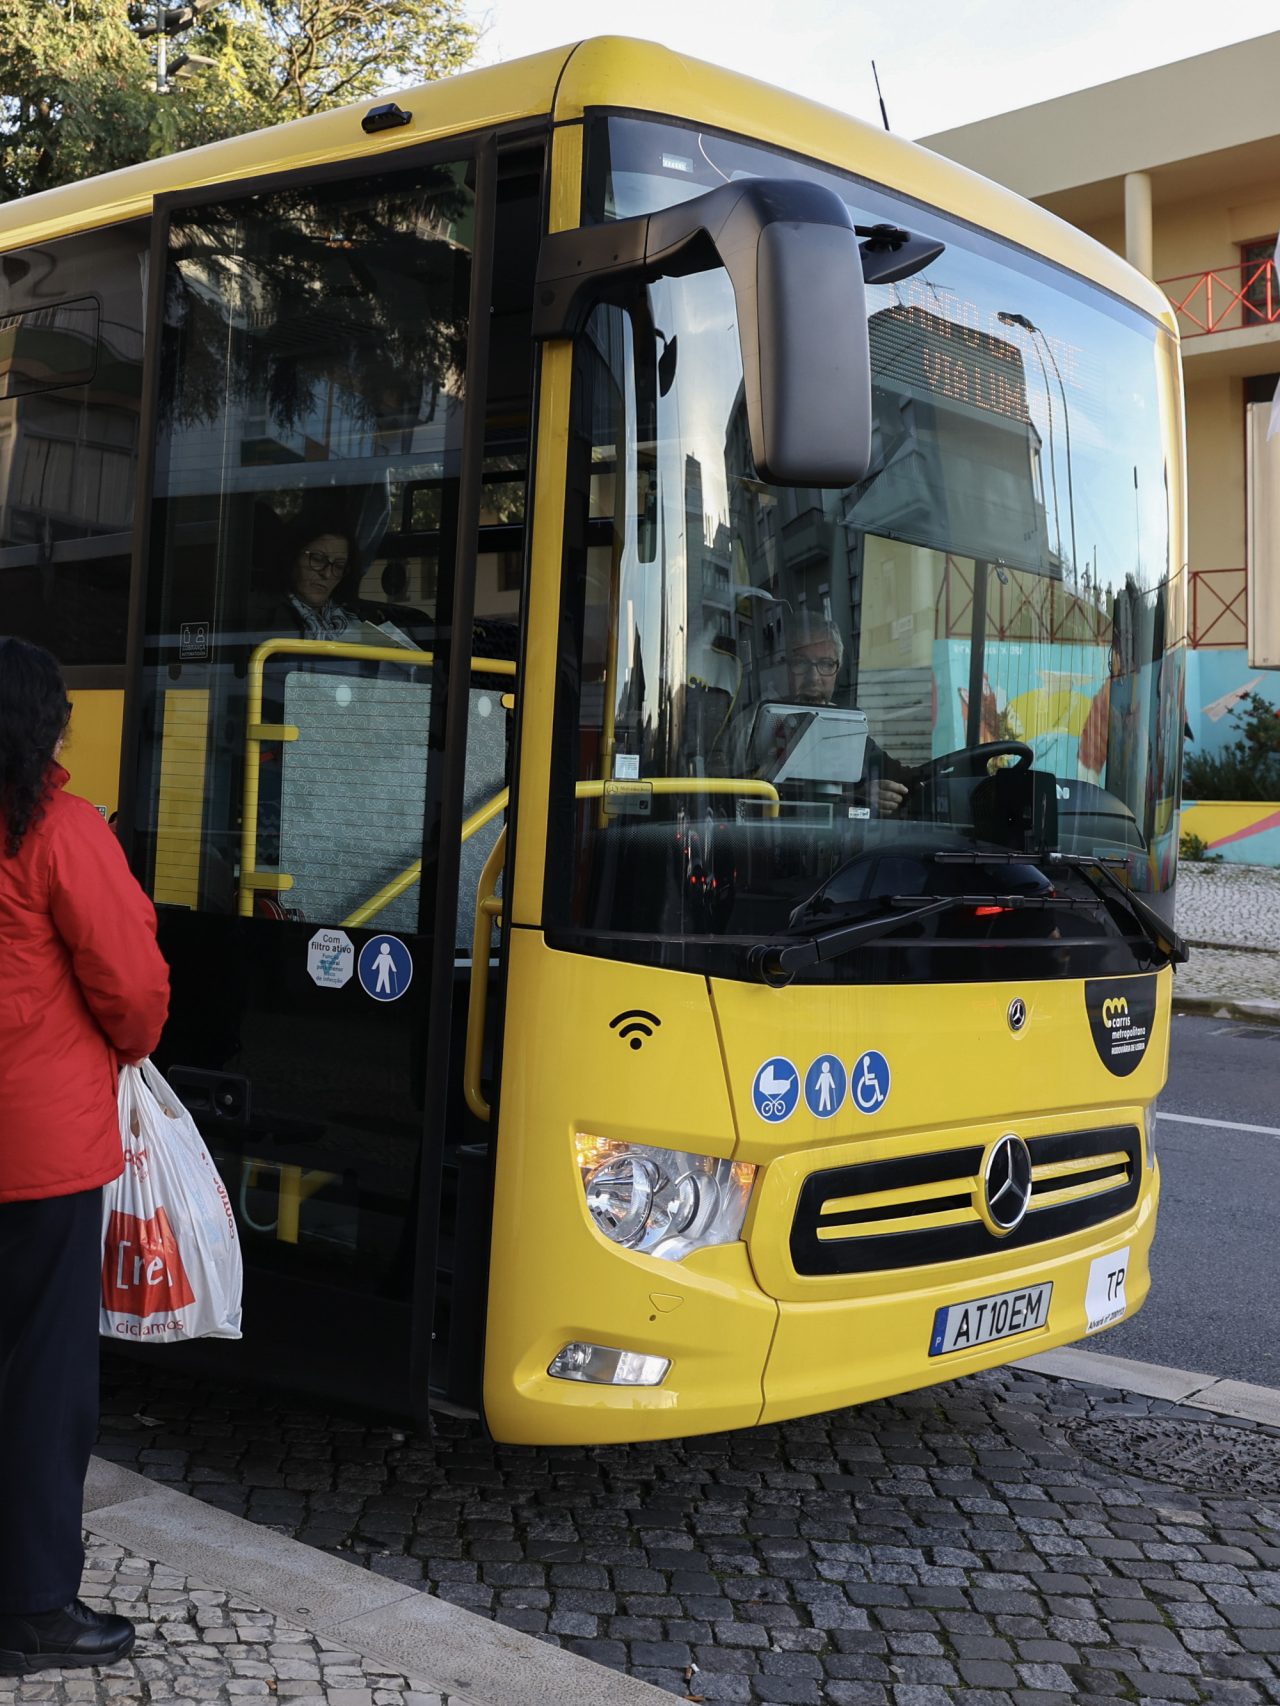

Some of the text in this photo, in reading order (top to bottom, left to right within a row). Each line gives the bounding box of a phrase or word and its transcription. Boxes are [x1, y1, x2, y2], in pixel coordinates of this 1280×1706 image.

[923, 348, 969, 401] VIA
[323, 934, 341, 944] Com
[311, 942, 352, 954] filtro ativo
[1112, 1016, 1131, 1028] carris
[1112, 1026, 1146, 1040] metropolitana
[1107, 1268, 1125, 1302] TP
[935, 1290, 1043, 1347] P AT10EM
[116, 1319, 184, 1337] ciclamos
